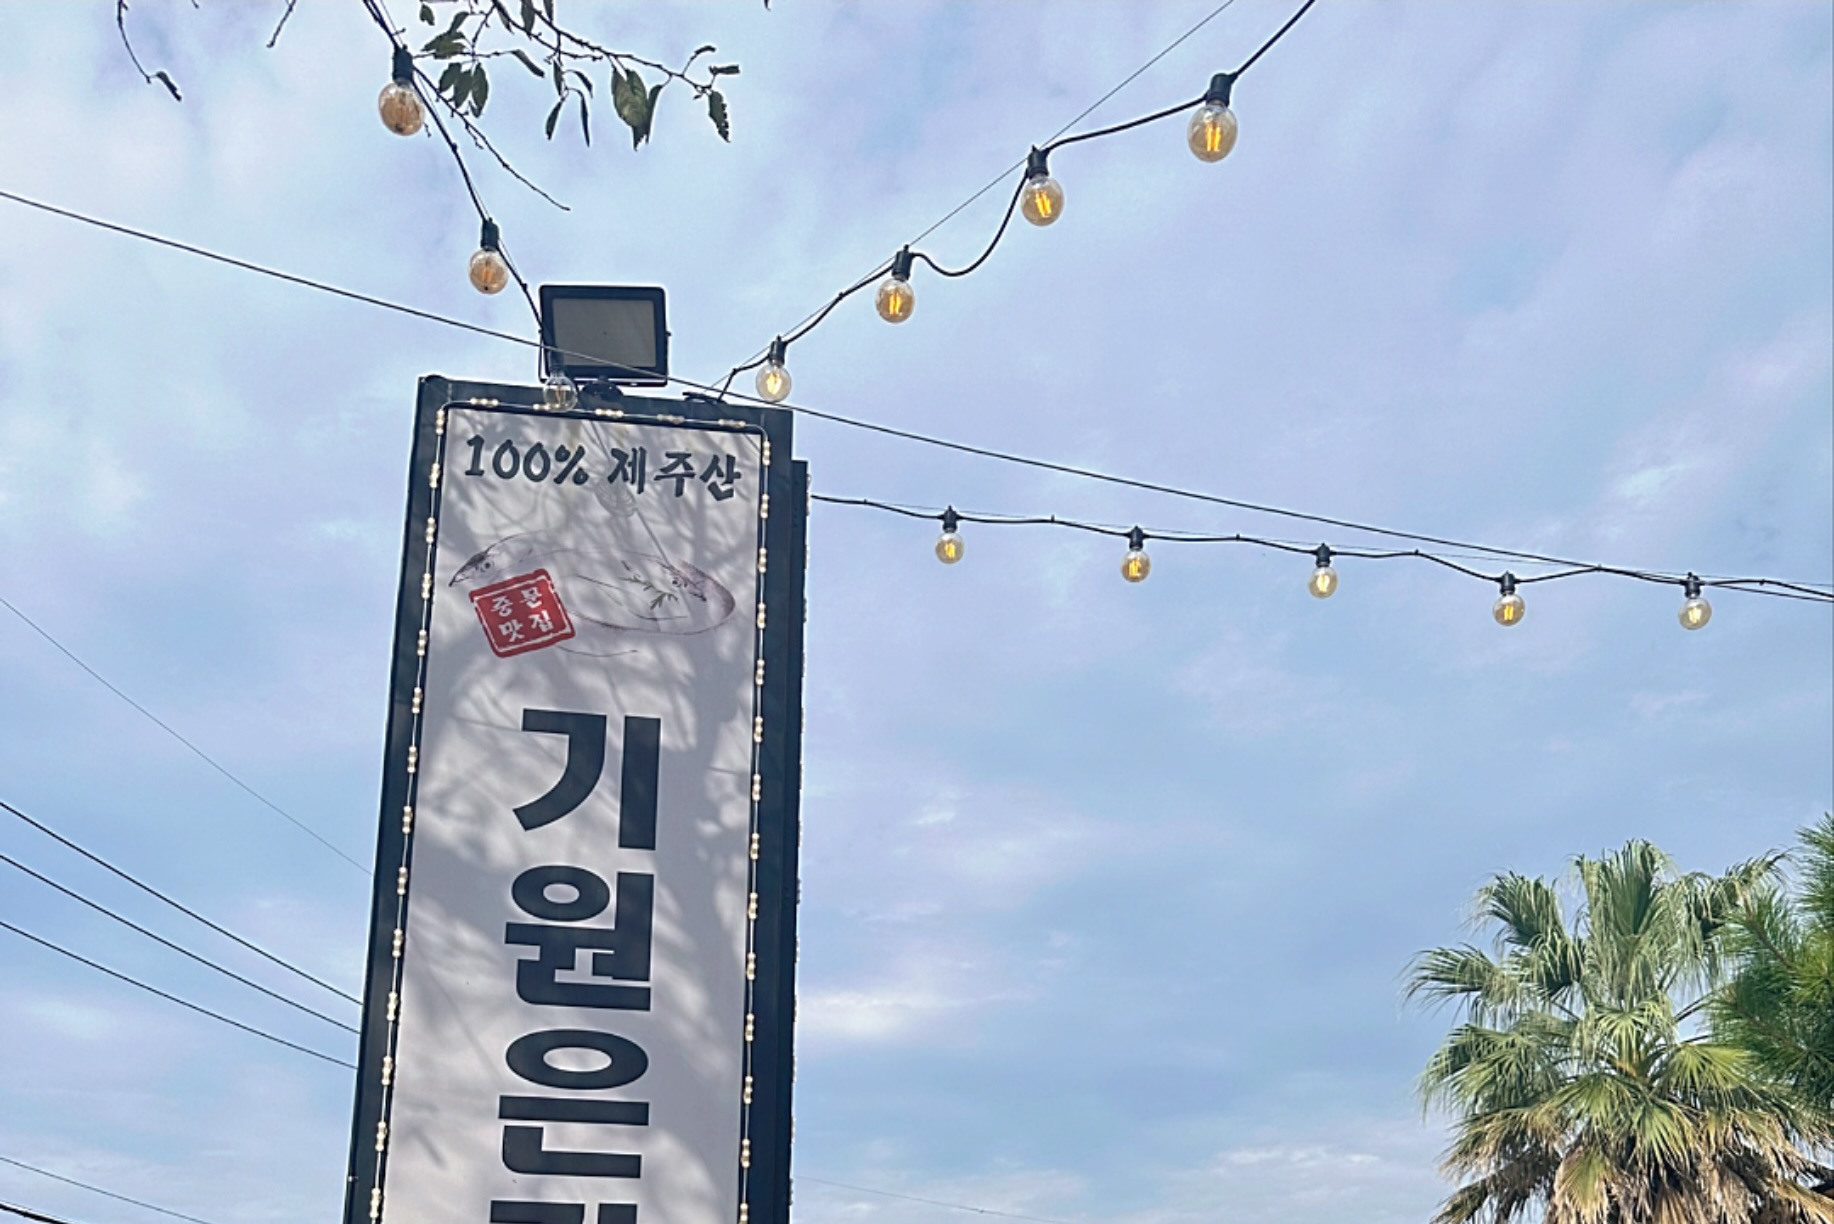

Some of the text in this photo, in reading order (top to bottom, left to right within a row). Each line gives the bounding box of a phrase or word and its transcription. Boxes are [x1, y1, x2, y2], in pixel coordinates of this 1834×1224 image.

[465, 434, 741, 501] 100% 제주산
[498, 609, 554, 643] 맛집
